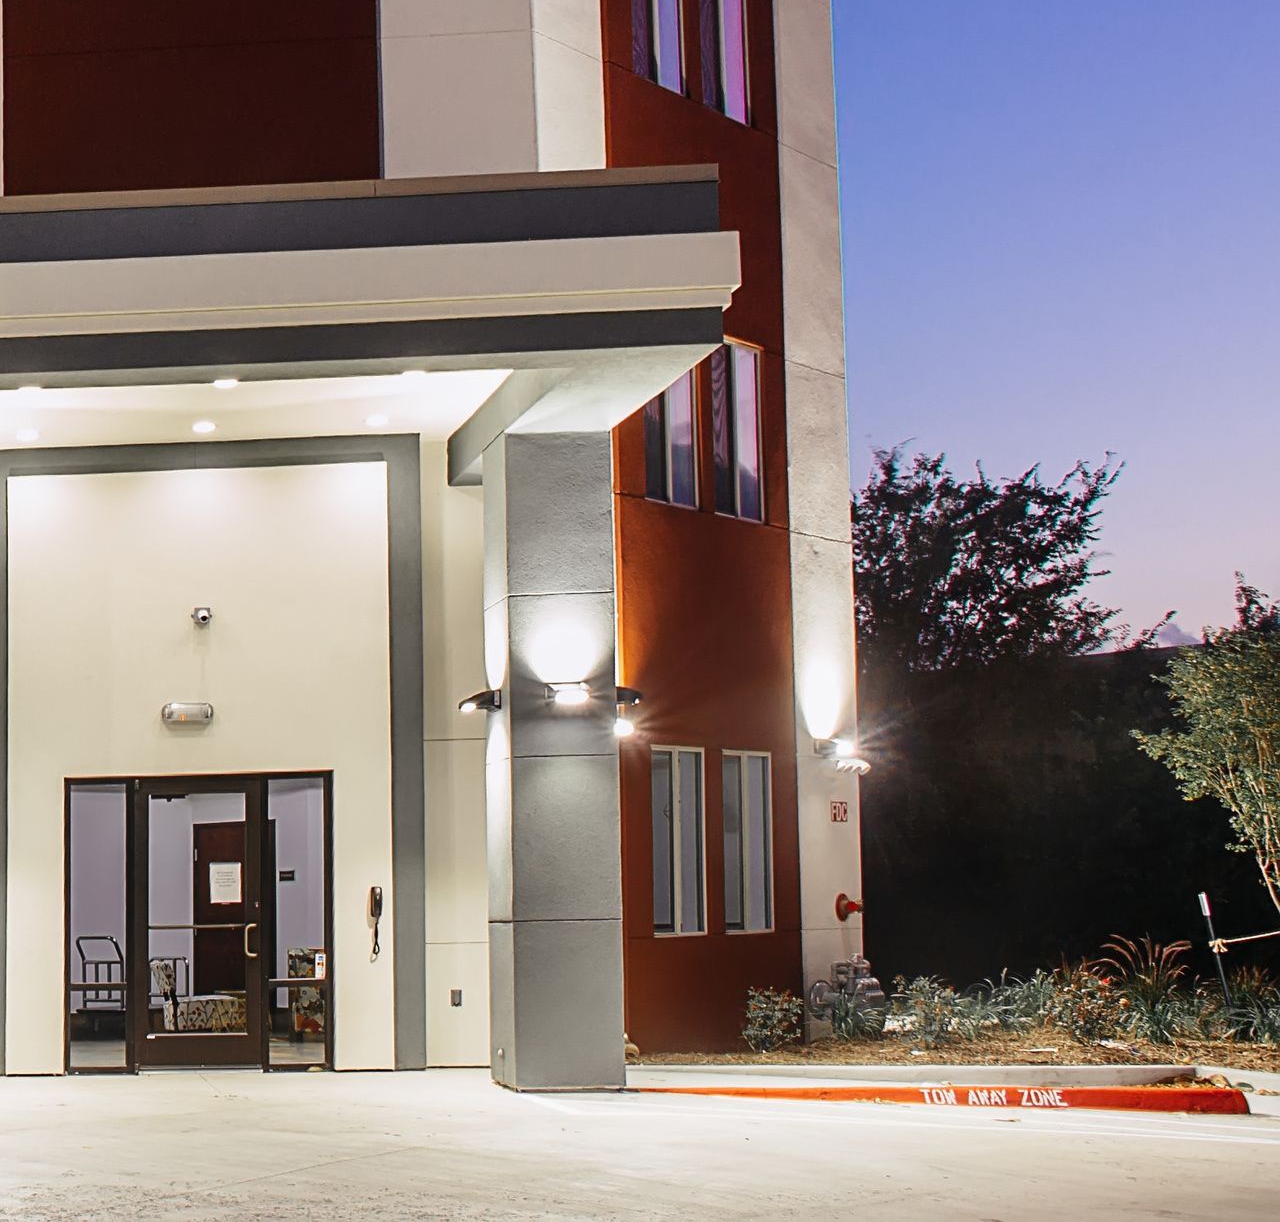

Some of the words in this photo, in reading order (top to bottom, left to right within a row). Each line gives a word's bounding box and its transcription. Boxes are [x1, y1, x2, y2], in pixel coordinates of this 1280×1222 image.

[831, 802, 847, 821] FDC
[920, 1089, 957, 1105] TOW
[967, 1089, 1007, 1106] AWAY
[1017, 1089, 1068, 1107] ZONE
